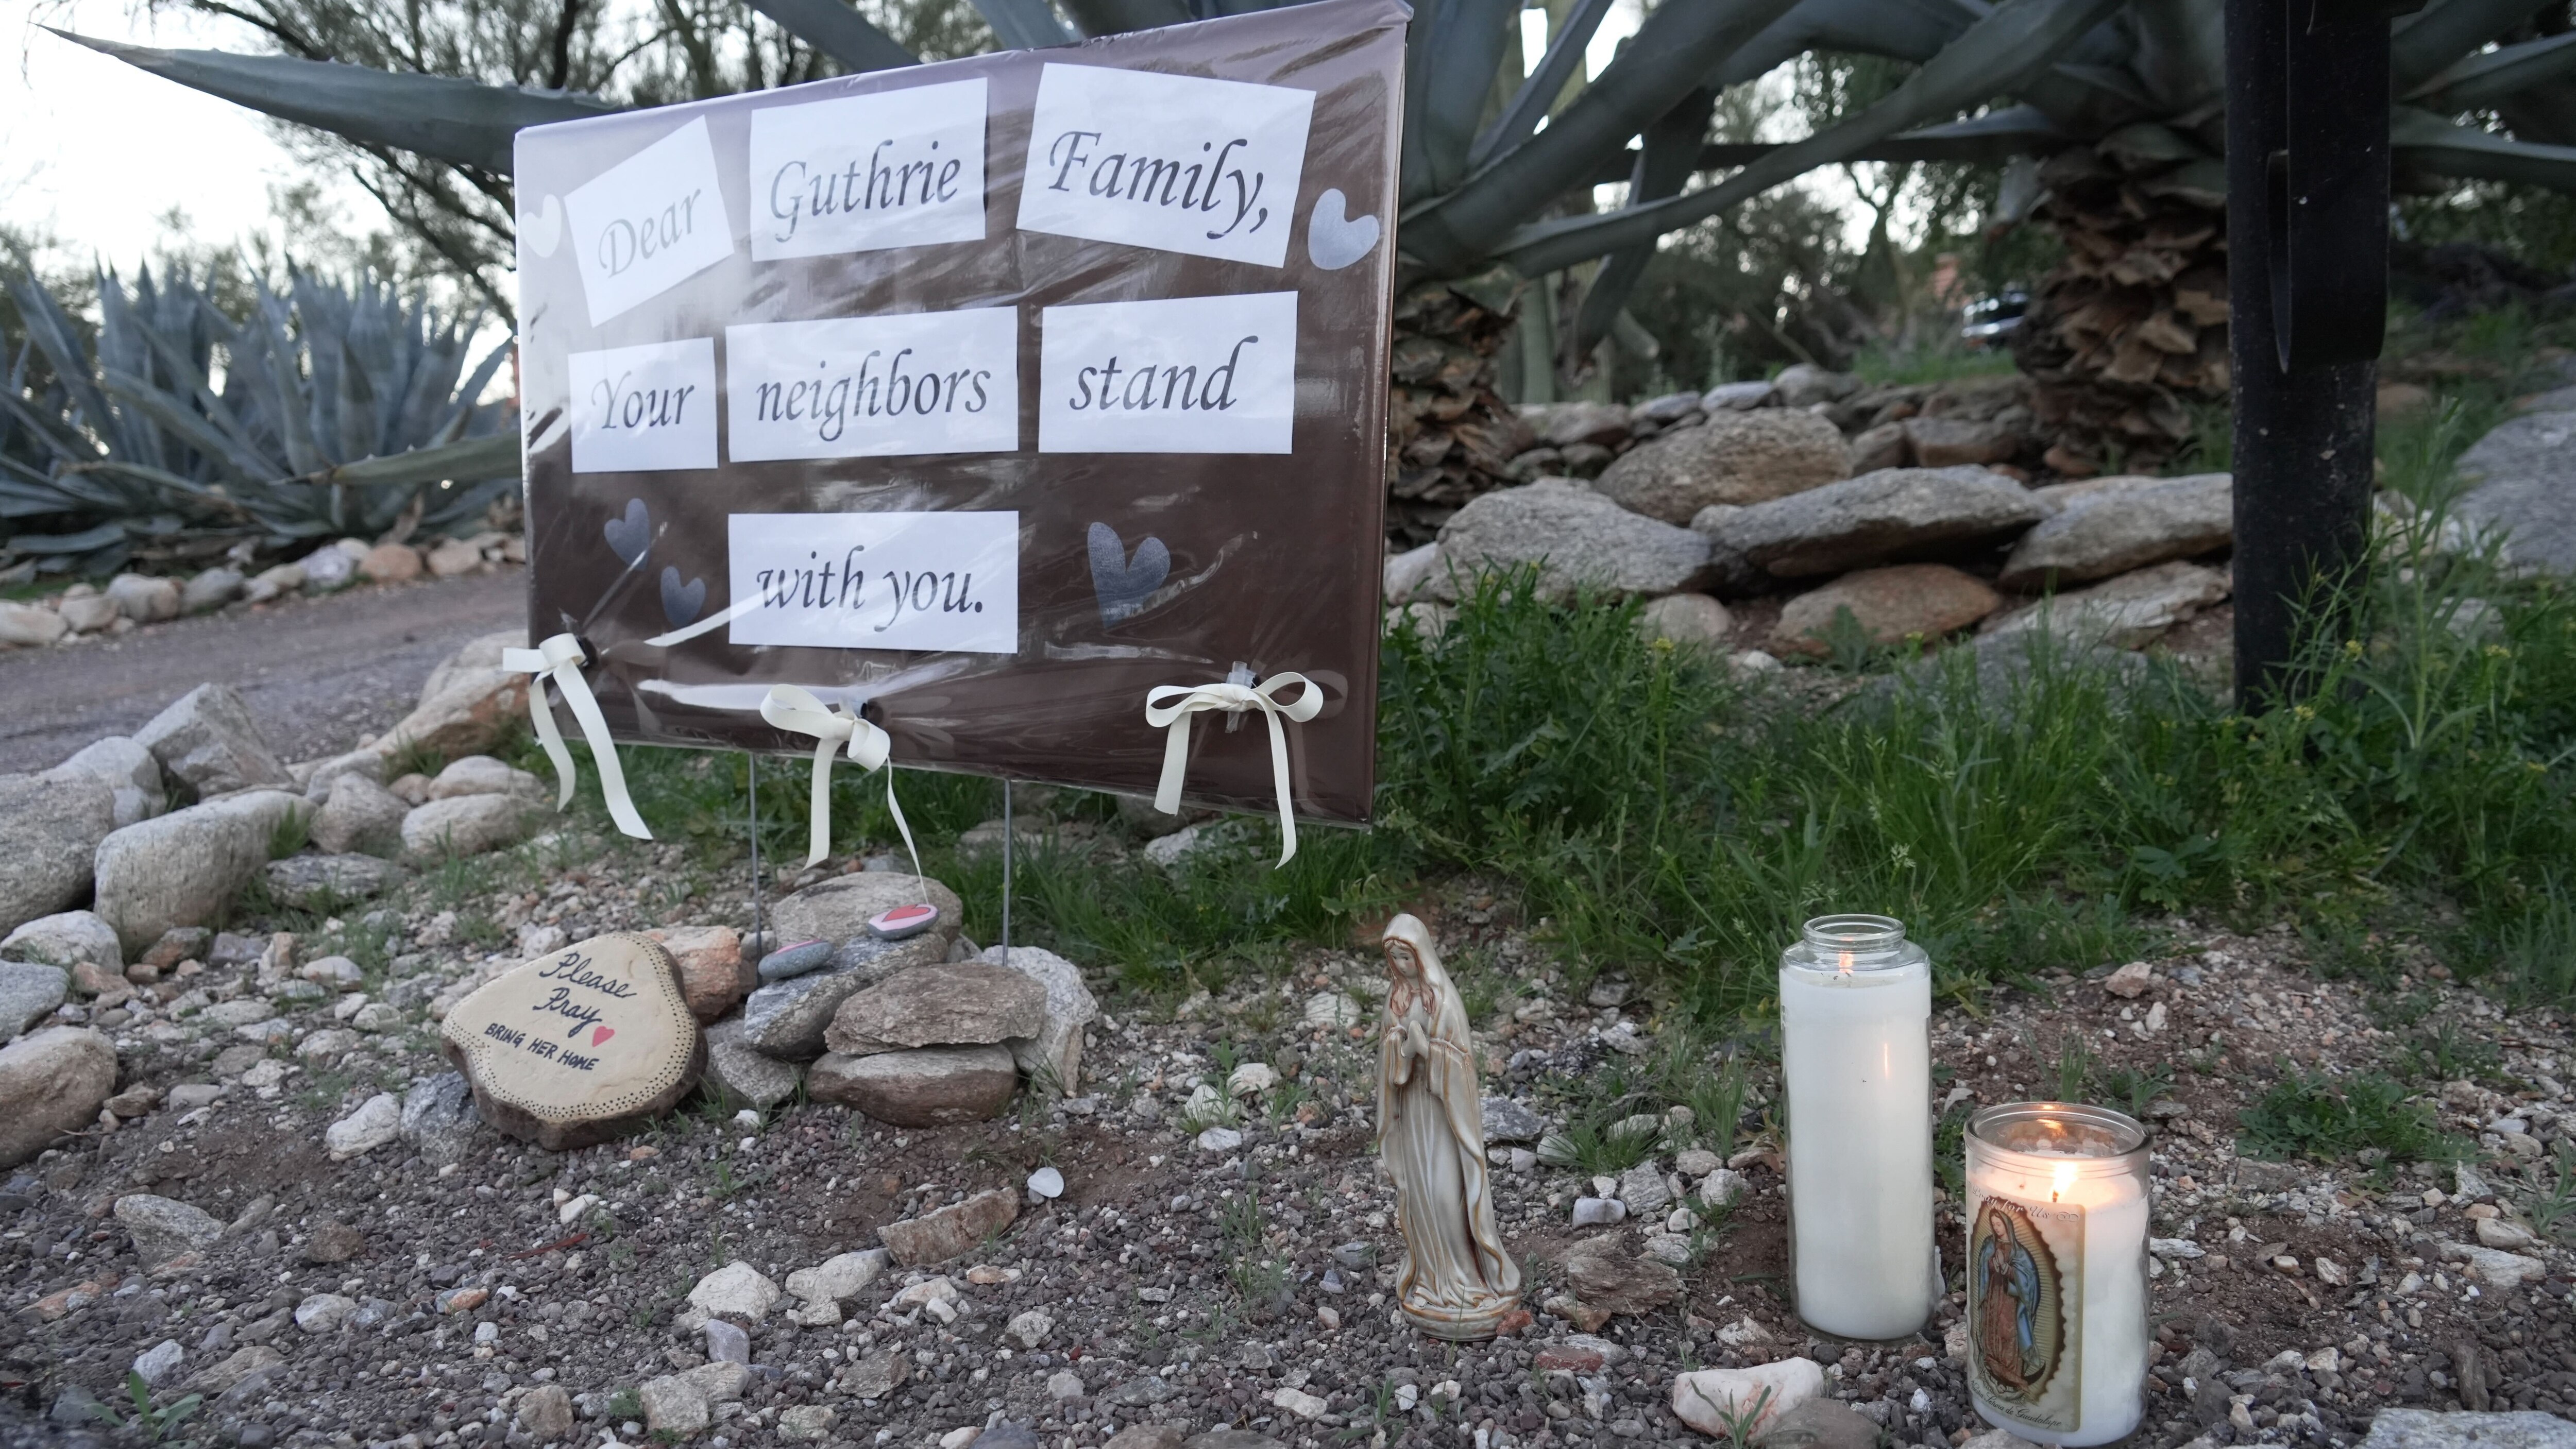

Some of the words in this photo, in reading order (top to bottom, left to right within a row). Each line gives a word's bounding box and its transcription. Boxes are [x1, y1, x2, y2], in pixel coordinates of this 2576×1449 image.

[598, 188, 701, 278] Dear
[770, 139, 961, 242] Guthrie
[1048, 131, 1269, 240] Family,
[591, 370, 694, 430] Your
[756, 348, 992, 441] neighbors
[1070, 335, 1259, 411] stand
[756, 544, 865, 610] with
[874, 570, 983, 632] you.
[538, 951, 637, 998] Please
[532, 987, 602, 1038] Pray
[484, 1022, 526, 1048] BRING
[527, 1037, 558, 1059] HER
[557, 1051, 600, 1071] HOME
[1972, 1186, 1997, 1208] Pray
[2000, 1200, 2024, 1213] for
[2030, 1205, 2050, 1219] Us
[1985, 1392, 2004, 1411] Señora
[2005, 1406, 2014, 1415] de
[2015, 1406, 2062, 1429] Guadalupe
